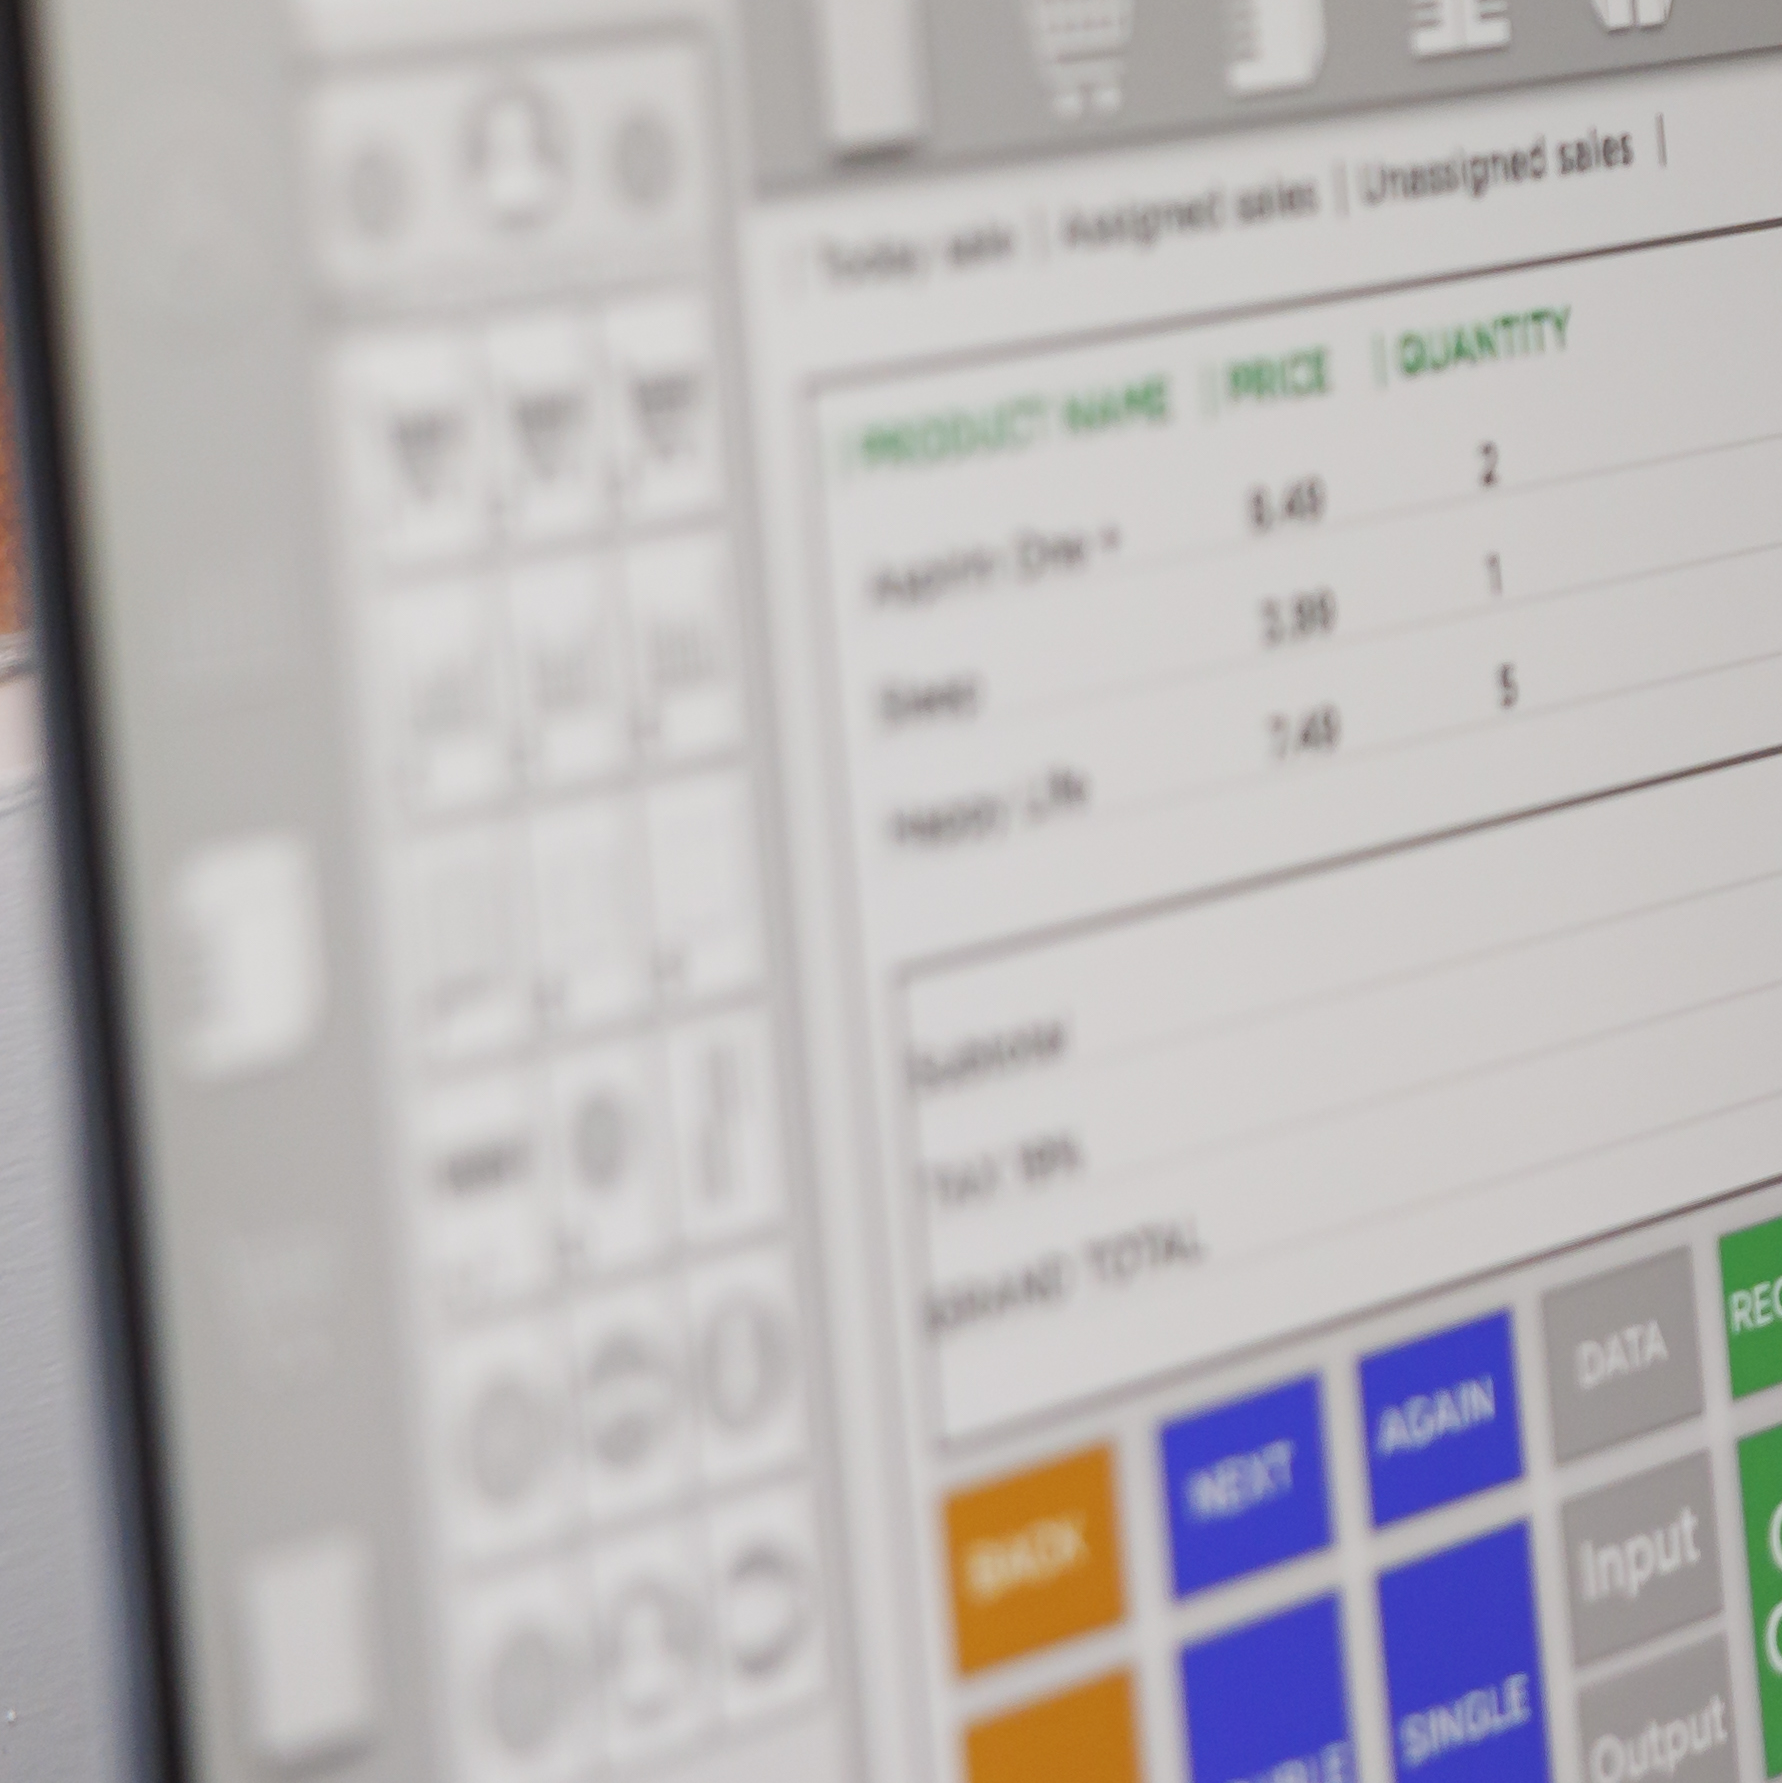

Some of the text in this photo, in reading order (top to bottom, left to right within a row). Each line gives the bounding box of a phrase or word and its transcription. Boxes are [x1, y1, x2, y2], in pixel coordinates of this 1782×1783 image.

[1360, 124, 1635, 208] Unassigned sales
[1061, 174, 1319, 255] Assigned sales
[1229, 345, 1331, 403] PRICE
[1399, 305, 1573, 379] QUANTITY
[1062, 371, 1171, 435] NAME
[1478, 439, 1500, 488] 2
[1485, 552, 1504, 595] 1
[1498, 661, 1519, 710] 5
[1576, 1321, 1670, 1389] DATA
[1376, 1375, 1497, 1457] AGAIN
[1184, 1438, 1295, 1516] NEXT
[1582, 1507, 1702, 1602] Input
[1400, 1672, 1532, 1768] SINGLE
[1589, 1696, 1729, 1783] Output
